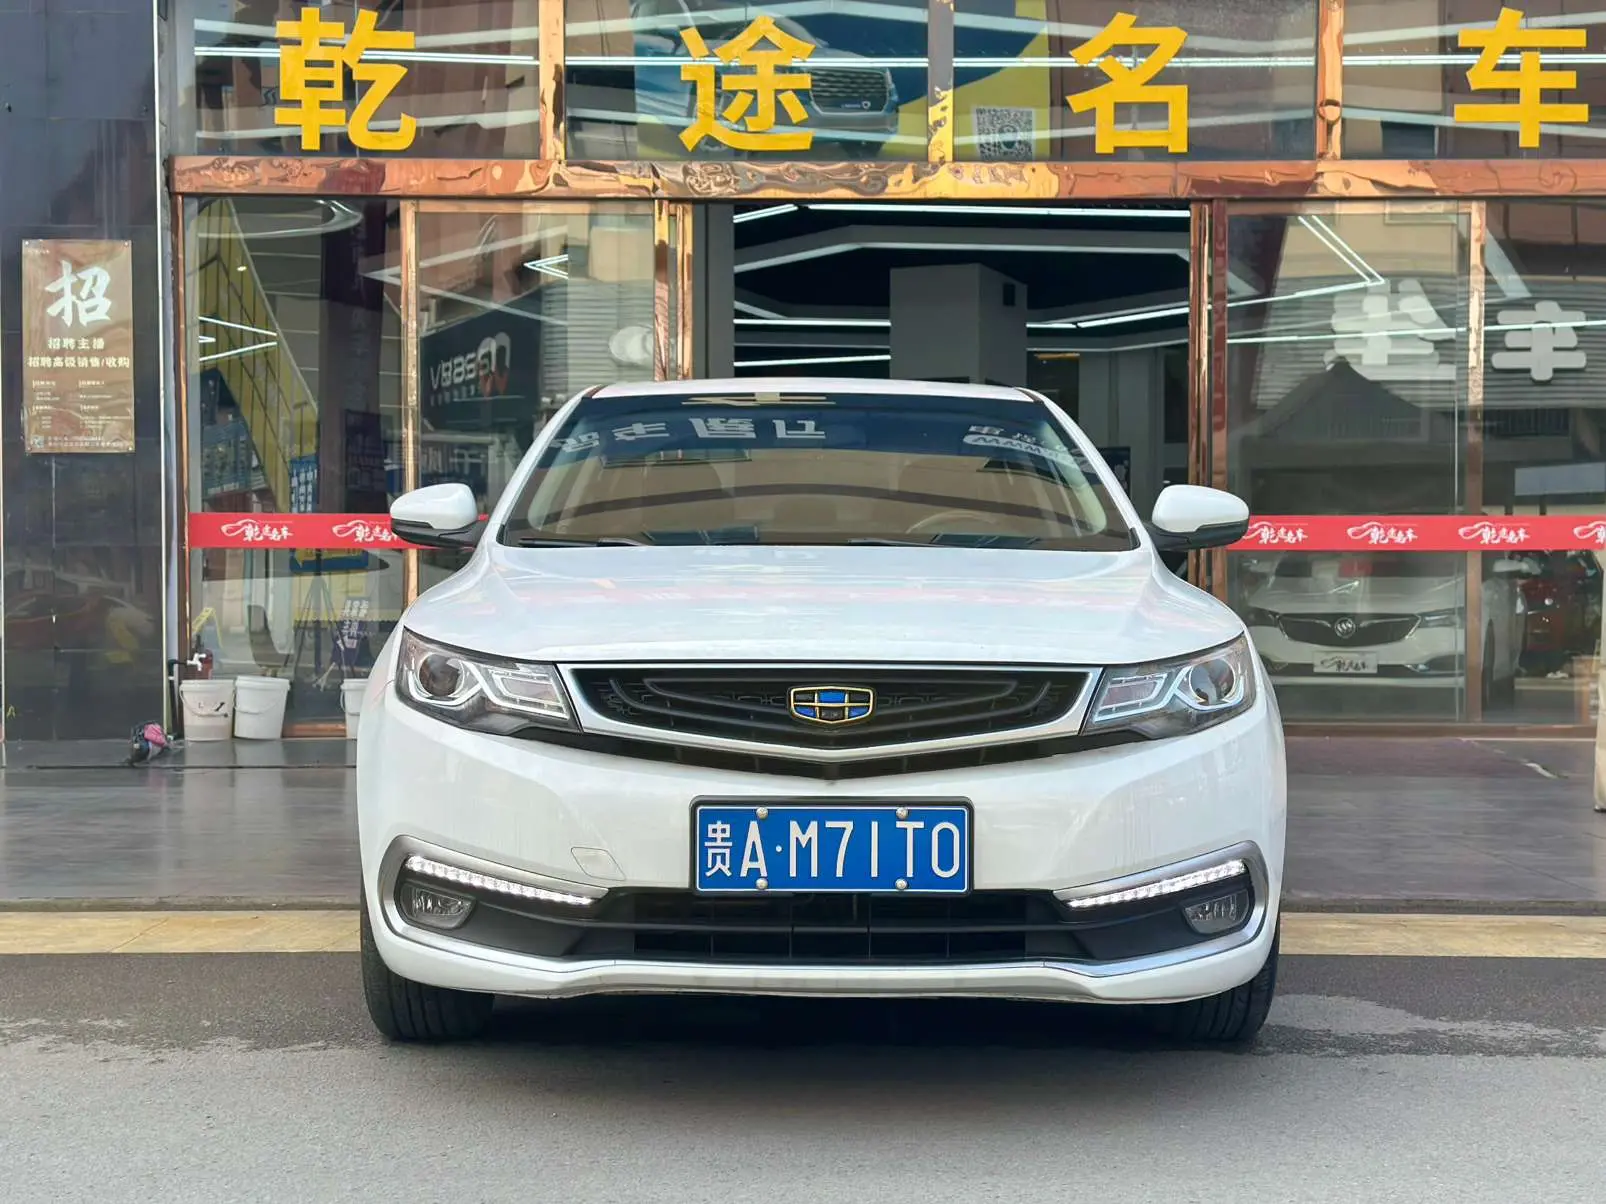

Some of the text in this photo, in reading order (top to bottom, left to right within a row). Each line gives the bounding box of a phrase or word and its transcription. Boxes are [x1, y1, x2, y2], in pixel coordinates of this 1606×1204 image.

[44, 260, 112, 327] 招
[48, 337, 105, 350] 招聘主播
